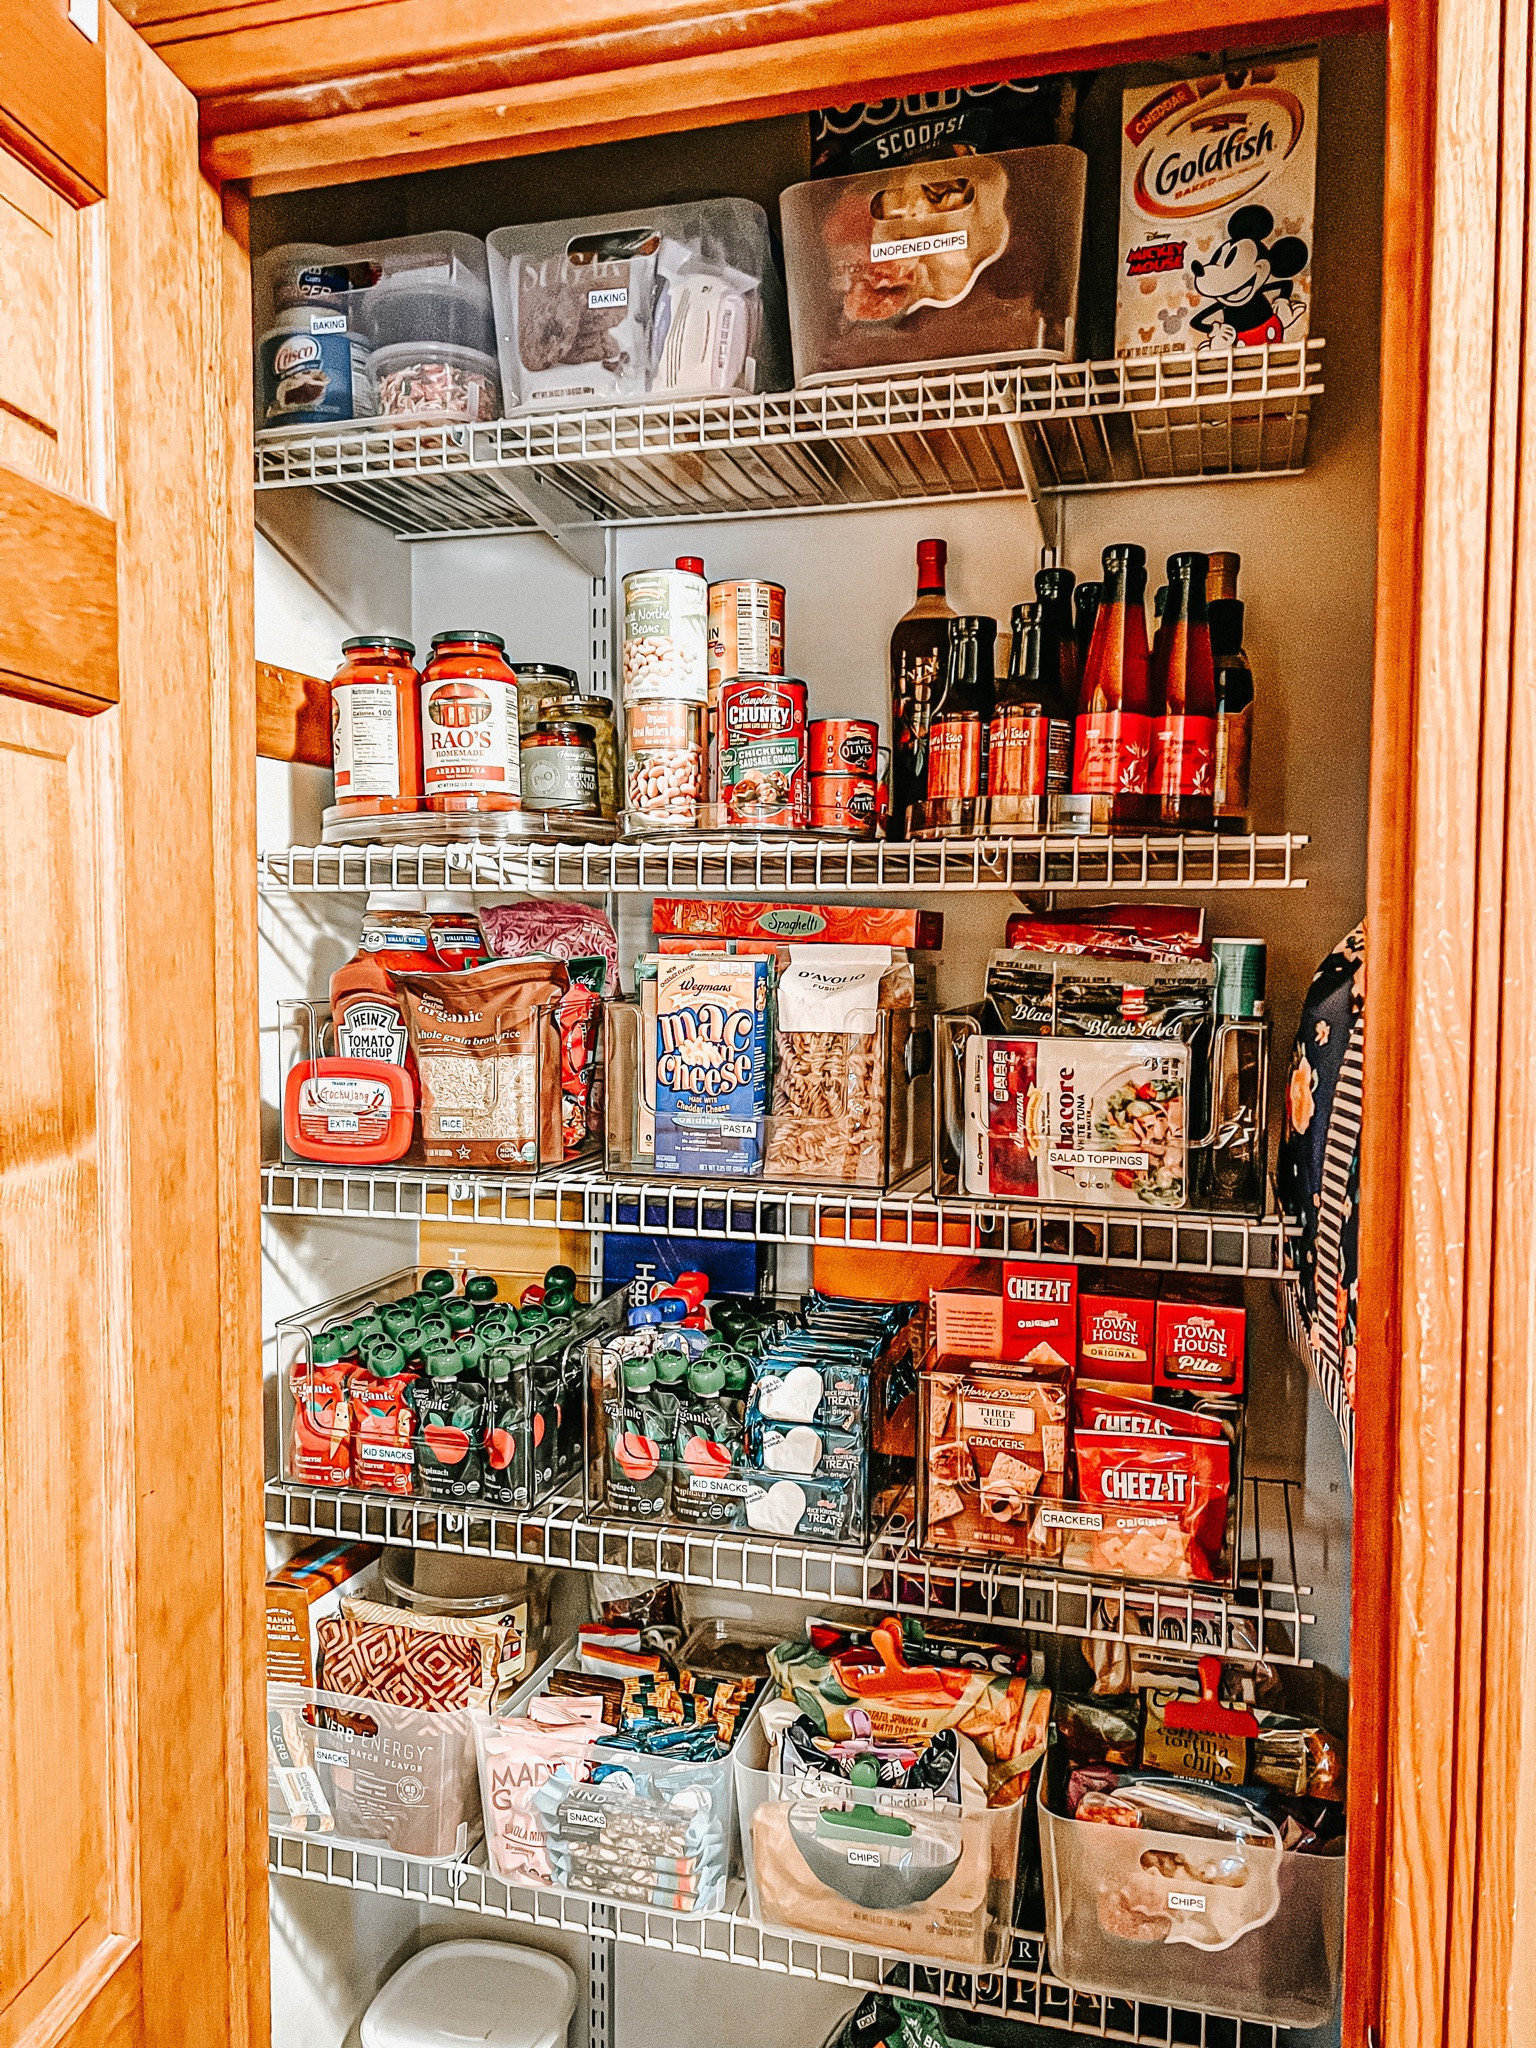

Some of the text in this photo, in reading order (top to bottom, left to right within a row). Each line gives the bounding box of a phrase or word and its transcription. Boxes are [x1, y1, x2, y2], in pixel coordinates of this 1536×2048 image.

[1135, 90, 1187, 134] CHEDDAR
[876, 113, 965, 160] SCOOPS!
[1155, 121, 1274, 195] Goldfish
[1144, 231, 1171, 241] Disney
[872, 235, 966, 258] UNOPENED CHIPS
[1127, 240, 1188, 263] MICKEY
[1127, 256, 1184, 276] MOUSE
[591, 293, 626, 304] BAKING
[313, 319, 345, 331] BAKING
[275, 345, 314, 370] Crisco
[378, 709, 392, 717] 100
[729, 705, 790, 726] CHUNKY
[431, 730, 491, 750] RAO'S
[436, 750, 485, 758] HOMEMADE
[738, 746, 796, 759] CHICKEN AND
[842, 745, 872, 757] OLIVES
[739, 757, 772, 769] SAUSAGE
[773, 754, 797, 766] GUMBO
[768, 913, 819, 935] Spaghetti
[996, 961, 1042, 971] RESEALABLE
[798, 971, 866, 984] D'AVOLIO
[1062, 976, 1112, 984] RESEALABLE
[680, 977, 733, 997] Wegmans
[353, 1013, 388, 1028] HEINZ
[417, 1005, 484, 1023] organic
[1011, 1005, 1052, 1023] Blac
[658, 1004, 753, 1054] mac
[1084, 1019, 1182, 1038] Black Label
[348, 1035, 395, 1048] TOMATO
[442, 1034, 471, 1045] grain
[500, 1029, 521, 1039] rice
[350, 1047, 393, 1058] KETCHUP
[657, 1053, 753, 1097] cheese
[320, 1087, 370, 1104] Gochujang
[676, 1100, 704, 1113] Cheddar
[1076, 1094, 1085, 1123] TUNA
[330, 1120, 357, 1128] EXTRA
[442, 1120, 462, 1128] RICE
[678, 1117, 722, 1125] ORIGINA
[1009, 1092, 1025, 1148] Wegmans
[723, 1125, 752, 1134] PASTA
[1050, 1153, 1143, 1166] SALAD TOPPINGS
[1092, 1317, 1137, 1332] TOWN
[1092, 1329, 1138, 1345] HOUSE
[1173, 1324, 1226, 1342] TOWN
[1091, 1348, 1138, 1359] ORIGINAL
[1173, 1339, 1227, 1357] HOUSE
[1178, 1355, 1222, 1373] Pita
[416, 1398, 449, 1412] rganic
[826, 1397, 860, 1406] TREATS
[978, 1407, 1016, 1419] THREE
[983, 1418, 1012, 1428] SEED
[968, 1436, 1025, 1450] CRACKERS
[363, 1448, 413, 1460] KID SNACKS
[825, 1460, 859, 1471] TREATS
[692, 1480, 748, 1493] KID SNACKS
[807, 1513, 843, 1527] TREATS
[1043, 1514, 1101, 1527] CRACKERS
[267, 1616, 295, 1624] RAHAM
[266, 1624, 297, 1632] RACKER
[890, 1713, 921, 1726] SPINACH
[922, 1718, 929, 1728] &
[324, 1715, 355, 1744] VERB
[871, 1723, 893, 1734] OMATO
[270, 1725, 289, 1760] VERB
[362, 1731, 426, 1761] ENERGY
[316, 1750, 349, 1764] SNACKS
[1183, 1744, 1233, 1780] chips
[385, 1758, 423, 1773] FLAVOR
[492, 1762, 548, 1792] MAD
[567, 1788, 607, 1804] KIND
[569, 1813, 606, 1825] SNACKS
[849, 1852, 880, 1863] CHIPS
[1170, 1896, 1204, 1908] CHIPS
